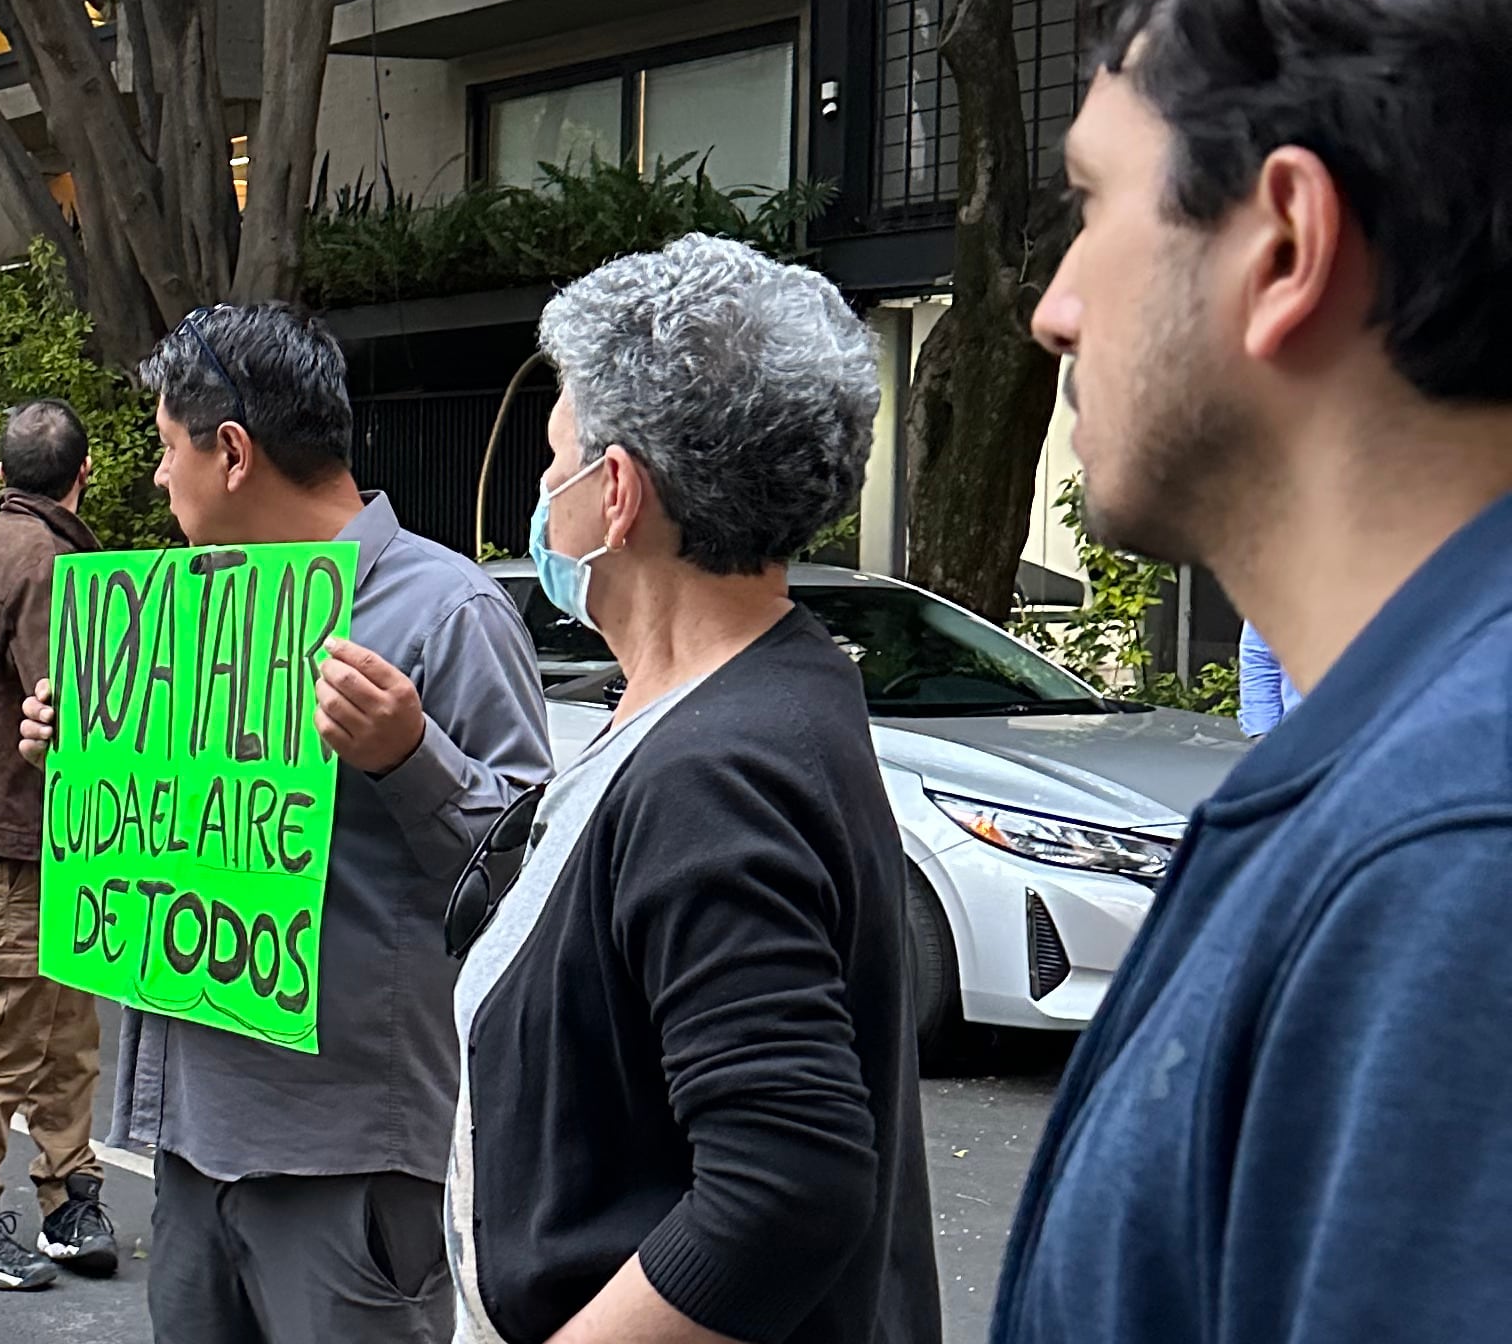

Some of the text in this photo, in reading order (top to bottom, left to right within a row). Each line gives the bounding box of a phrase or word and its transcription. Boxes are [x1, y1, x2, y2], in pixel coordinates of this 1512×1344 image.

[189, 549, 343, 767] TALAR
[196, 776, 316, 873] AIRE
[73, 879, 312, 1015] DE TODOS
